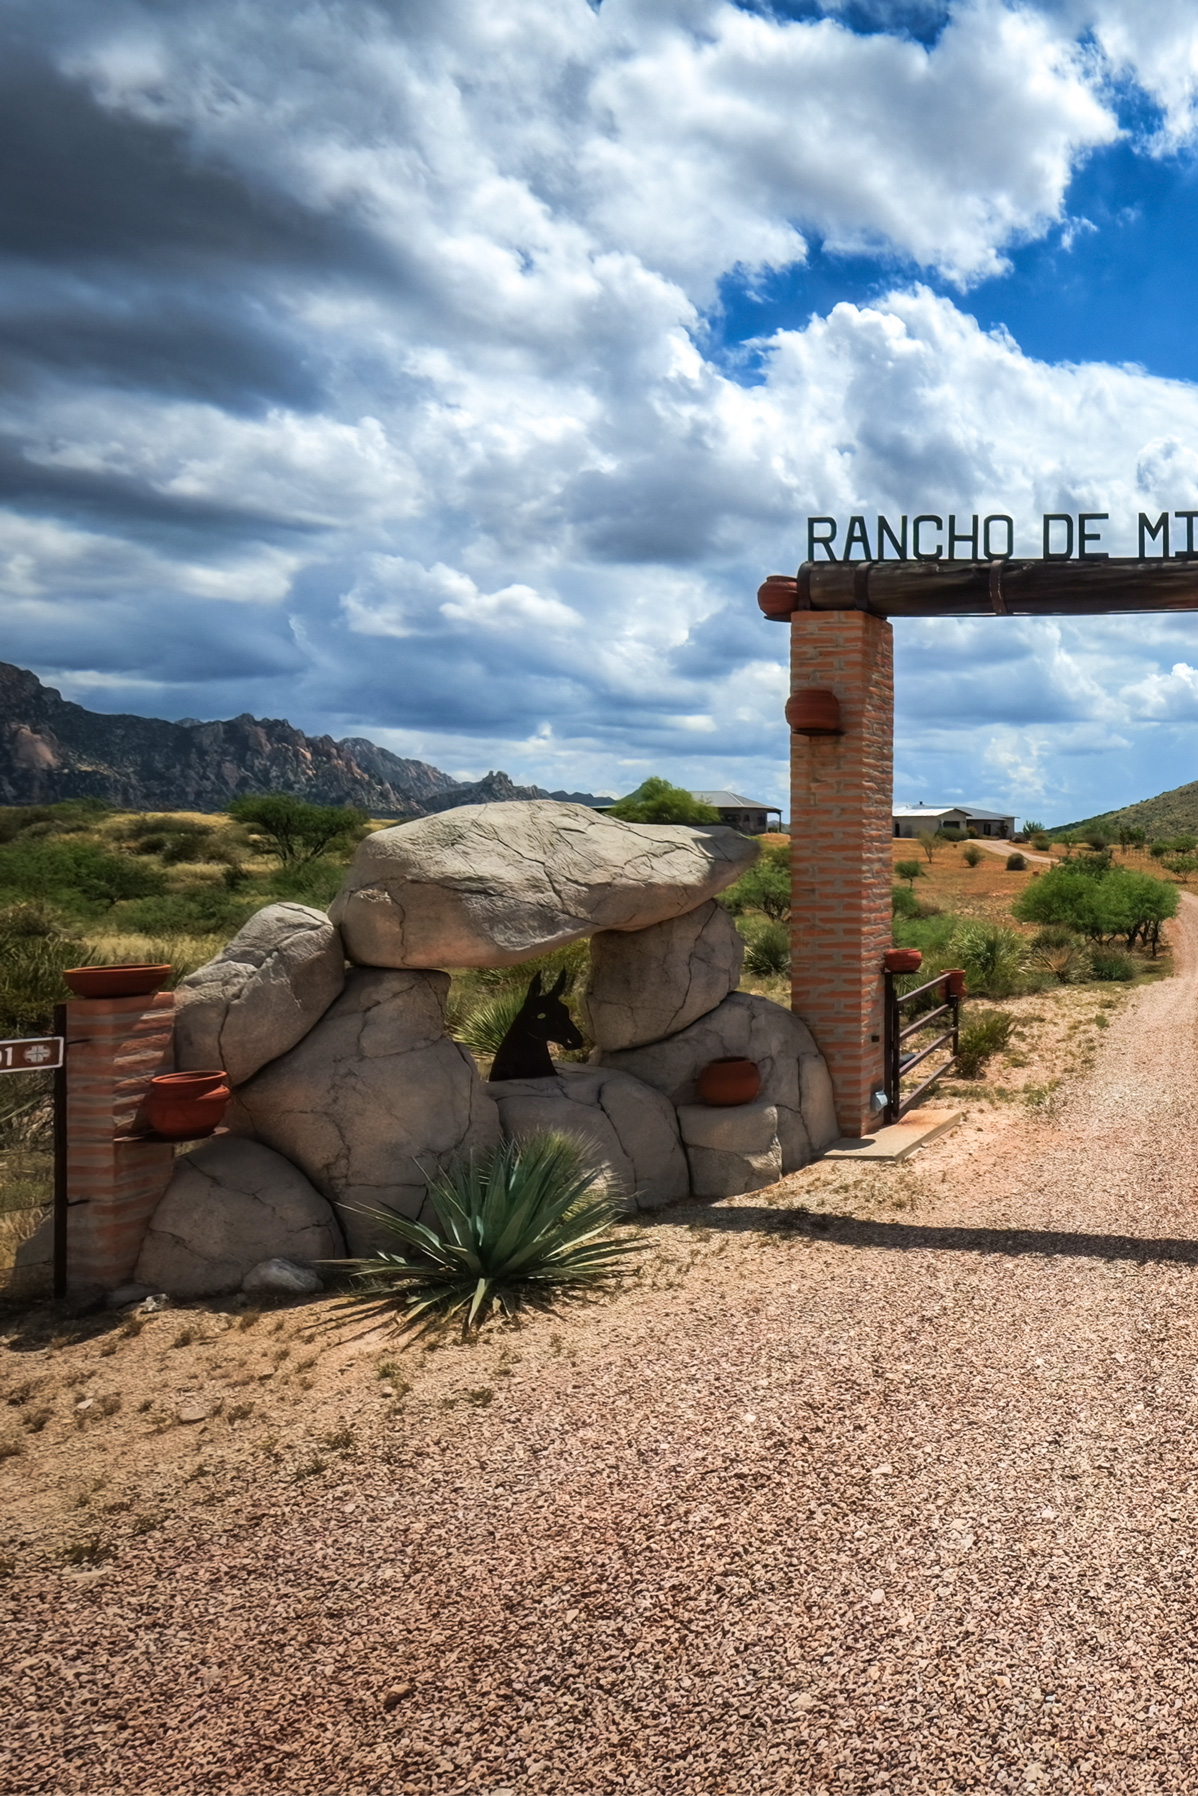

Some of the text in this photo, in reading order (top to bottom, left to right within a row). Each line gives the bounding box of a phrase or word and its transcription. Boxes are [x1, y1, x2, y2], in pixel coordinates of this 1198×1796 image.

[807, 515, 1014, 563] RANCHO
[1044, 513, 1109, 558] DE
[0, 1046, 13, 1066] 1
